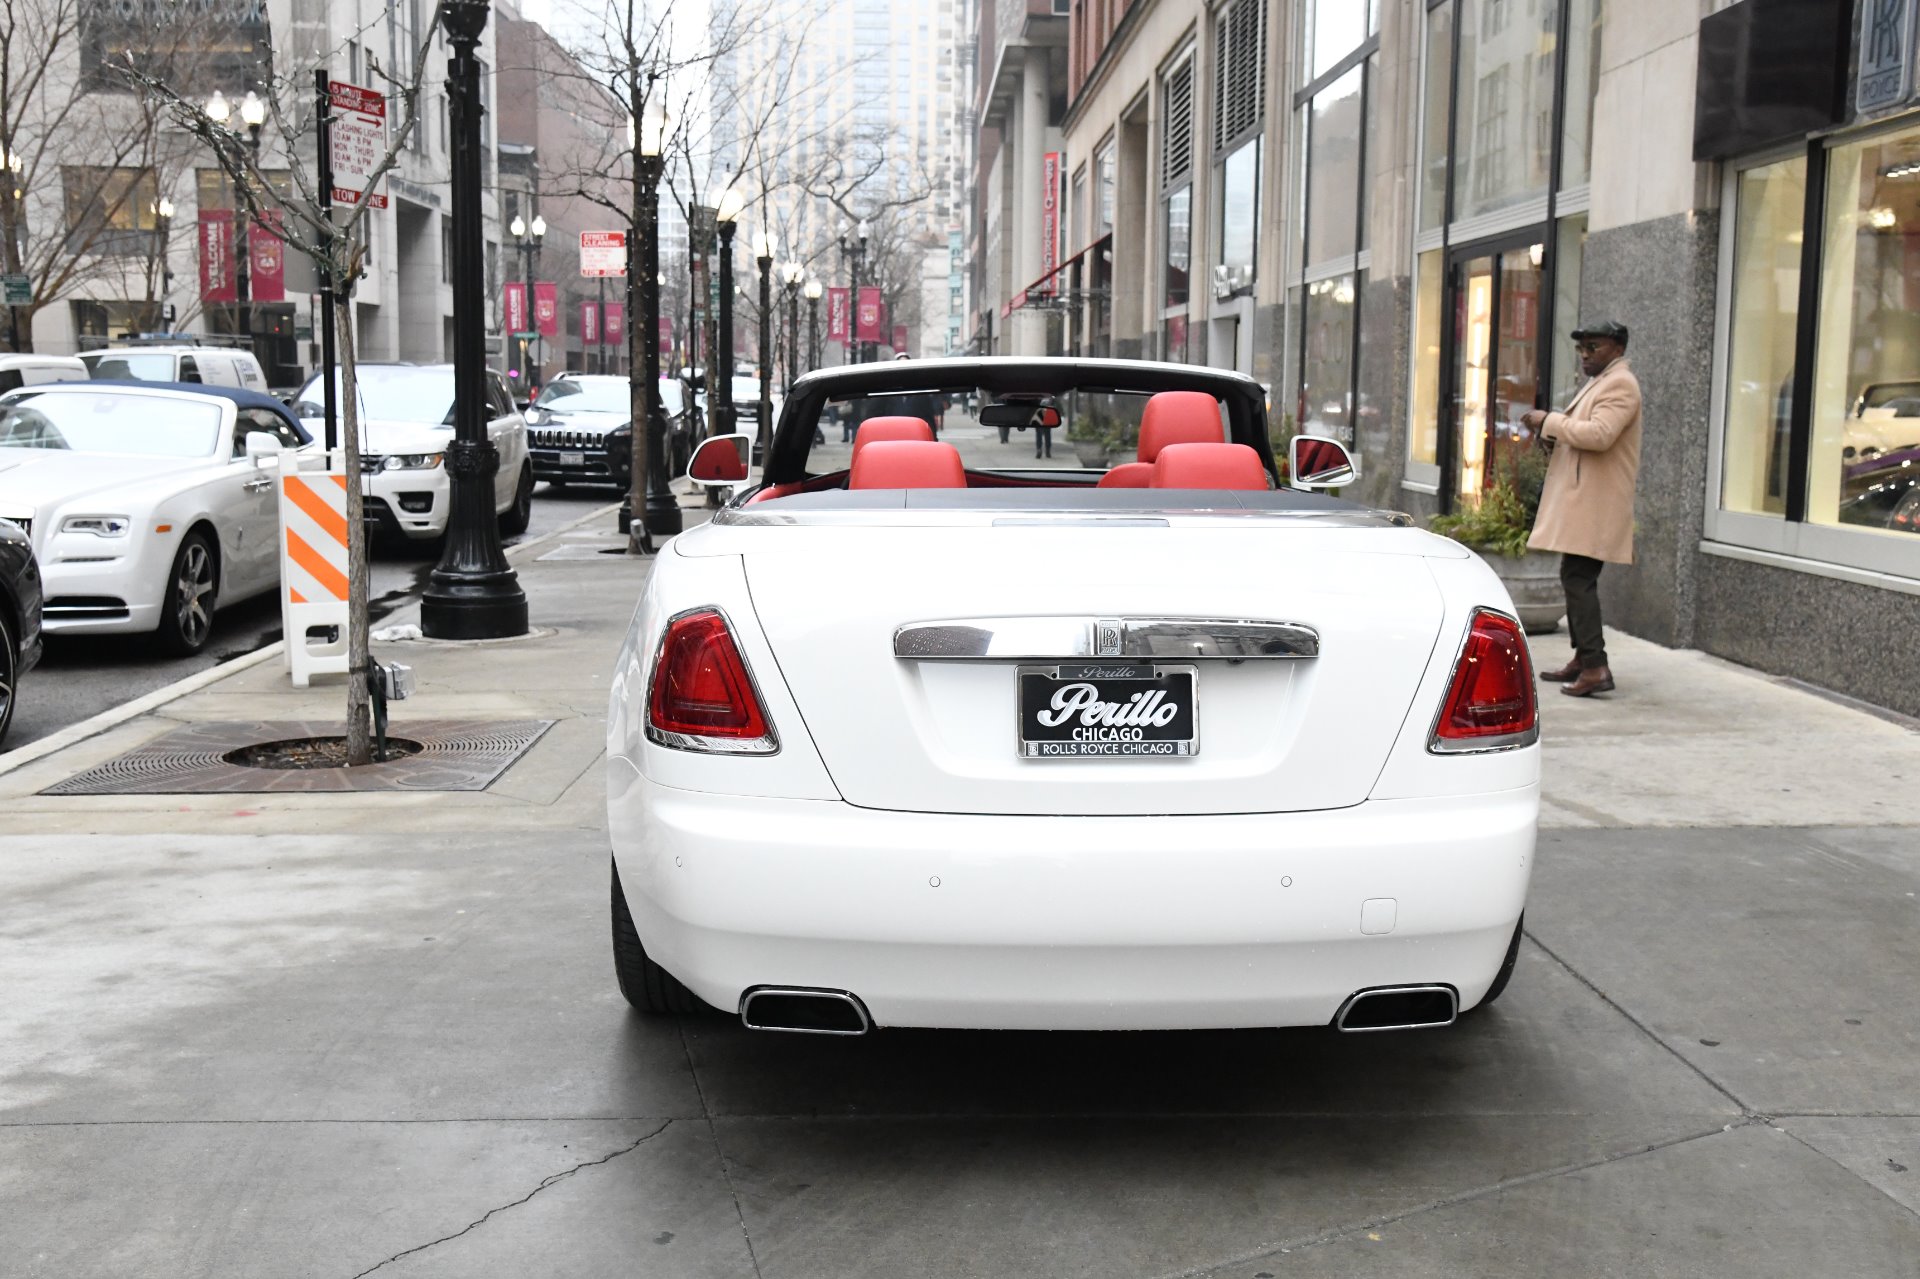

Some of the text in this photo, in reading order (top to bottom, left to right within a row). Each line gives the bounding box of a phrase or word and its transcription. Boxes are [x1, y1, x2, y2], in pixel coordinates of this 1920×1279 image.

[332, 83, 340, 95] 15
[1862, 72, 1901, 98] ROYCE
[364, 99, 381, 115] ZONE
[332, 121, 384, 141] FLASHING LIGHTS
[334, 131, 341, 140] 10
[341, 133, 351, 142] AM
[362, 137, 372, 147] PM
[334, 142, 348, 151] MON
[355, 146, 375, 158] THURS
[334, 151, 341, 161] 10
[341, 153, 352, 162] AM
[362, 157, 372, 167] PM
[334, 162, 346, 171] FRI
[350, 165, 364, 175] SUN
[335, 188, 356, 203] TOW
[207, 222, 219, 290] WELCOME
[1078, 666, 1136, 679] Perillo
[1036, 682, 1179, 728] Perillo
[1072, 727, 1143, 742] CHICAGO
[1043, 743, 1078, 756] ROLLS
[1080, 743, 1119, 756] ROYCE
[1122, 743, 1174, 756] CHICAGO
